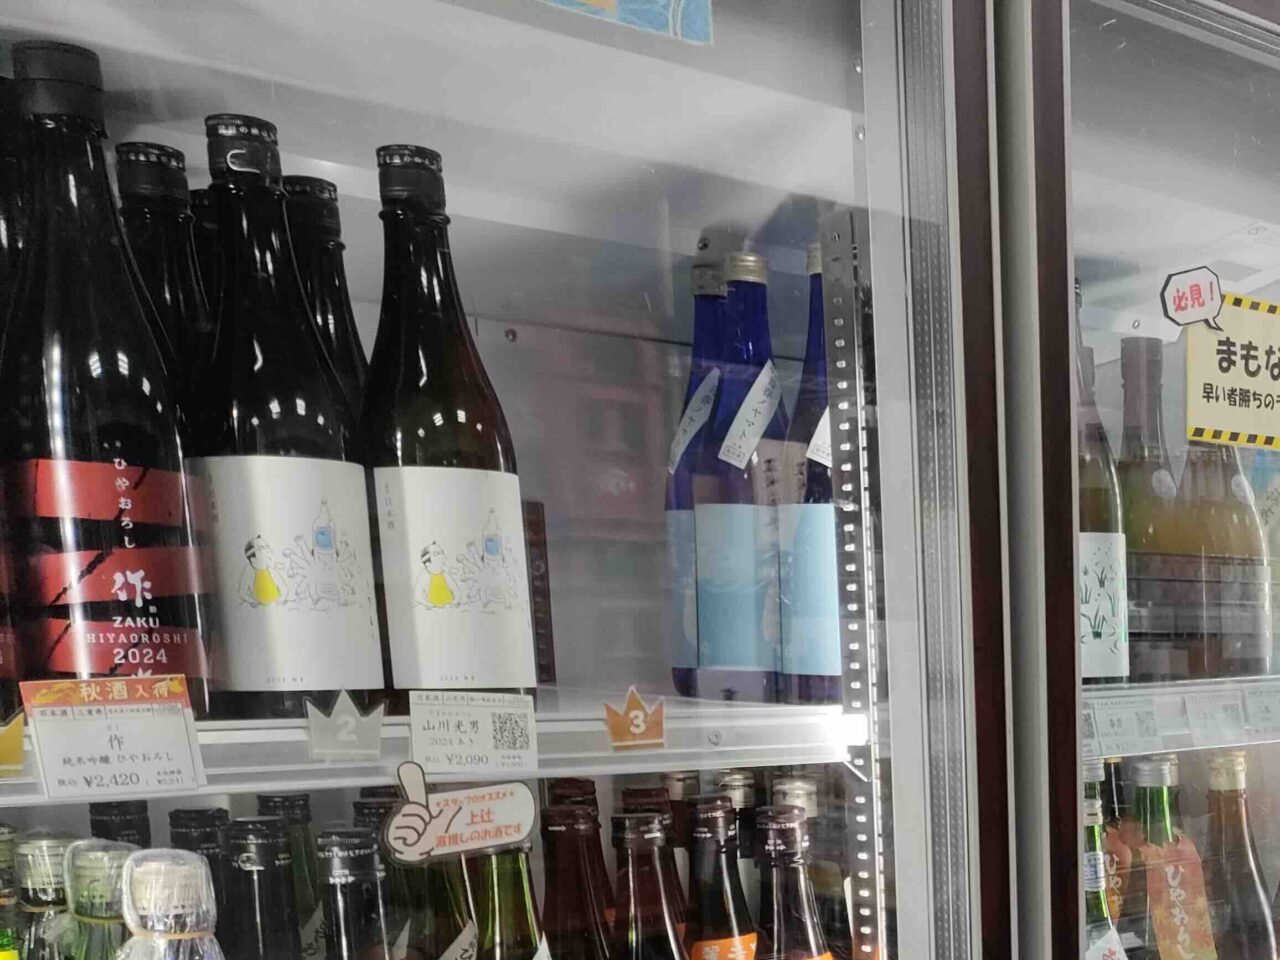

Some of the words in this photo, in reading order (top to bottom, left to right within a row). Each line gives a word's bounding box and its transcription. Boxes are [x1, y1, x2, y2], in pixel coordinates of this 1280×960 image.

[1173, 281, 1214, 312] 必見！
[113, 458, 136, 548] ひやおろし
[111, 569, 152, 608] 作
[112, 617, 159, 628] ZAKU
[87, 632, 188, 644] HIYAOROSHI
[113, 649, 168, 664] 2024
[79, 681, 169, 702] 秋酒入荷
[336, 716, 359, 742] 2
[422, 719, 479, 734] 山川光男
[628, 708, 646, 734] 3
[108, 734, 124, 751] 作
[446, 754, 489, 767] ¥2,090
[83, 773, 140, 789] ¥2,420
[1164, 864, 1196, 960] ひやおろし
